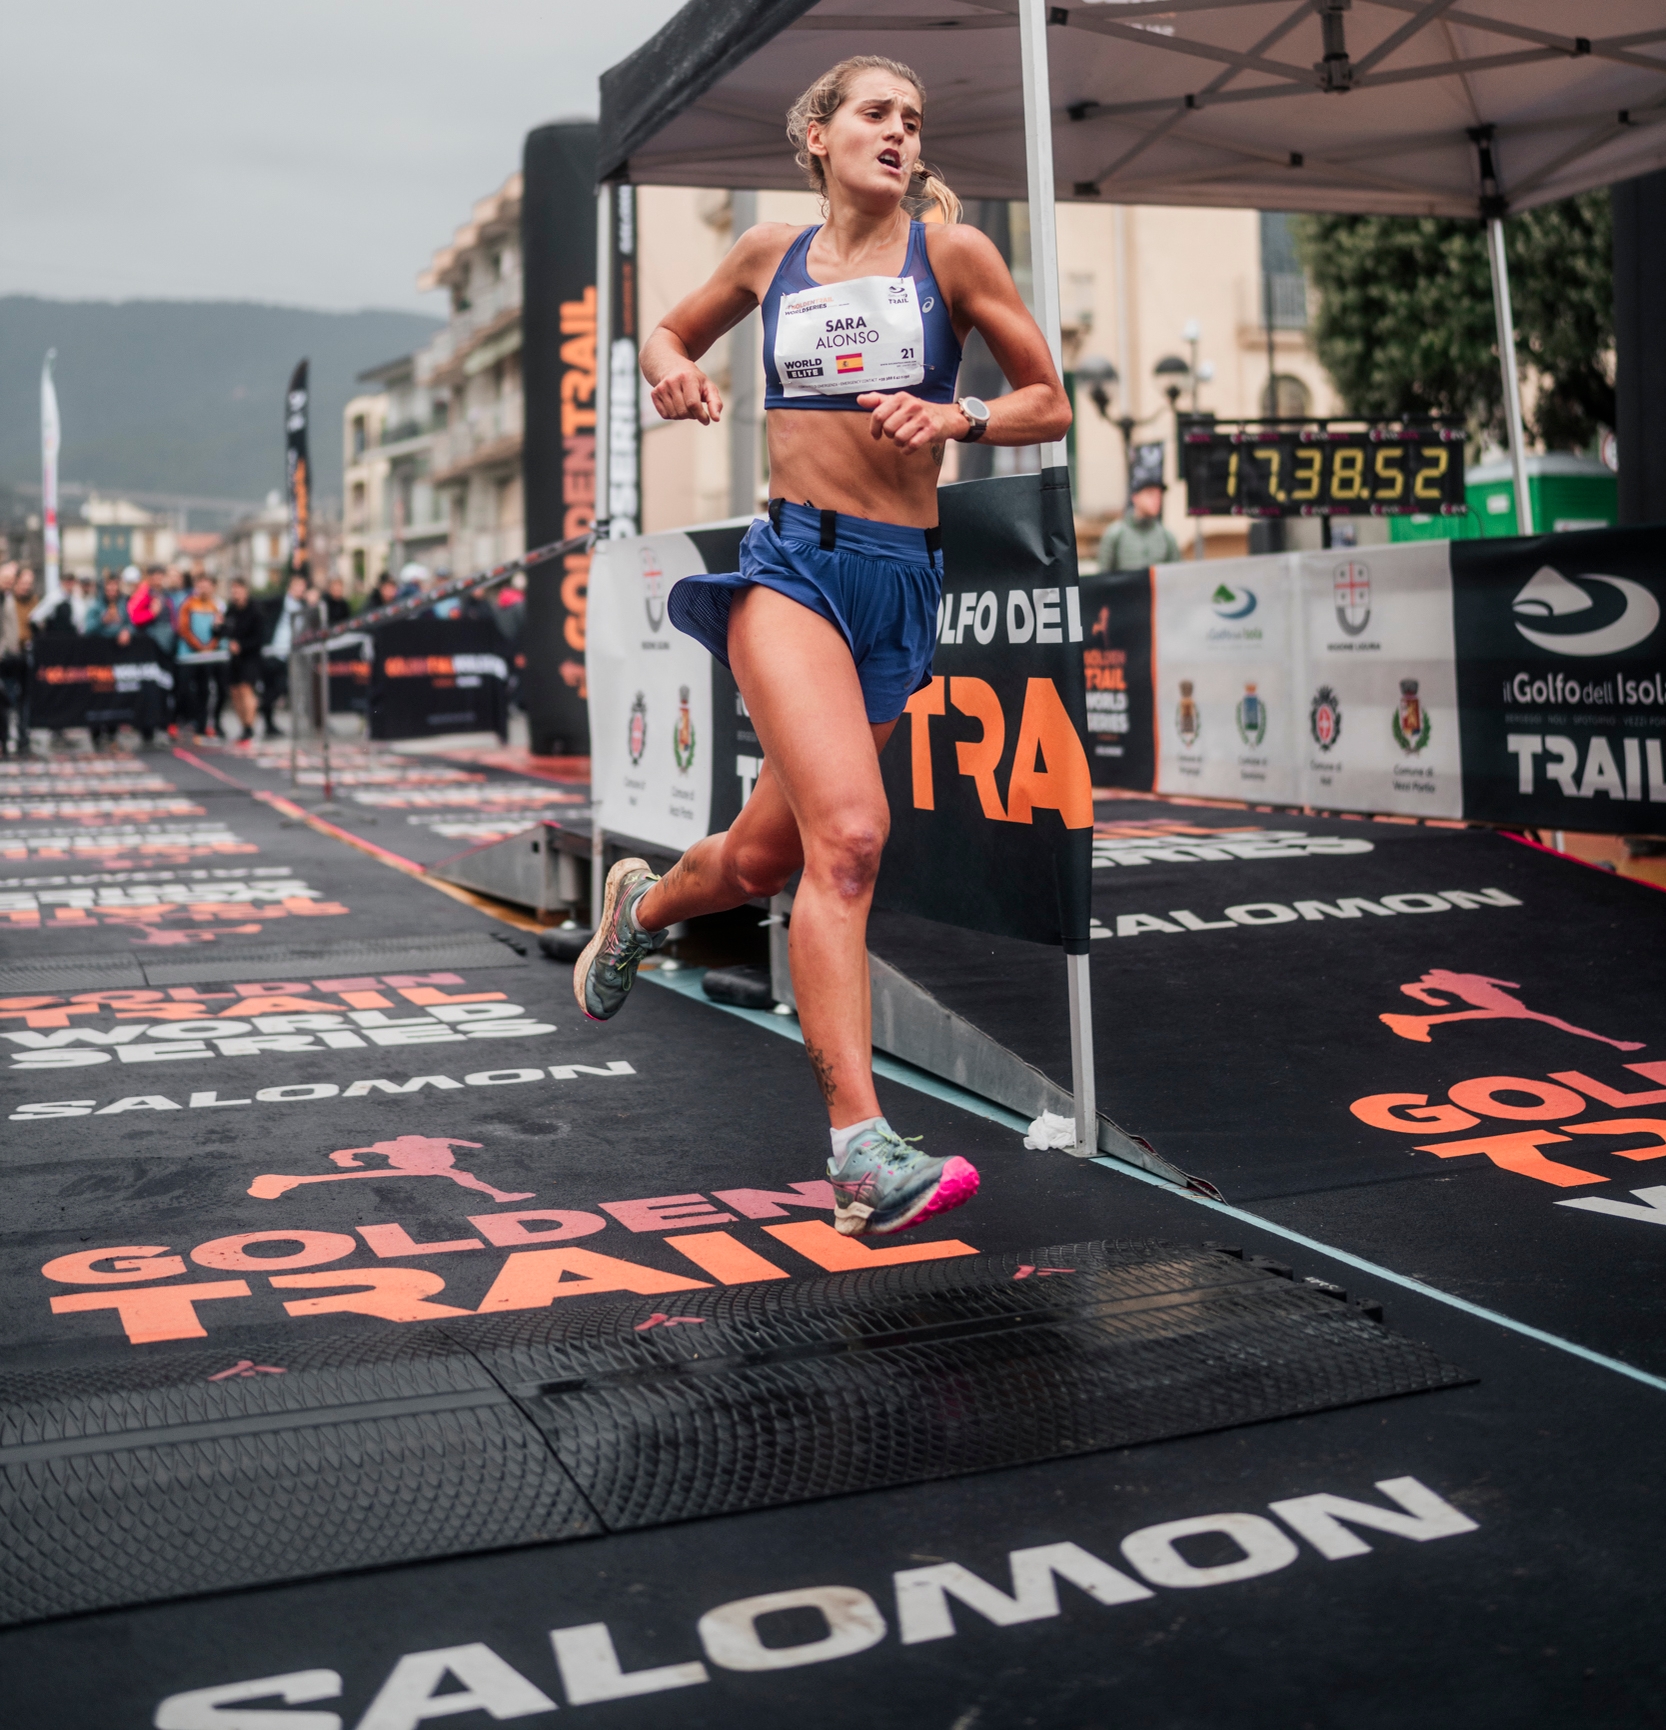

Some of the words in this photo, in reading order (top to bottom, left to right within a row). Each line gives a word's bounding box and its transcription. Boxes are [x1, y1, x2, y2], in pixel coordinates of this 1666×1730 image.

[815, 330, 880, 350] ALONSO
[825, 316, 867, 332] SARA
[784, 358, 823, 370] WORLD
[791, 369, 819, 378] ELITE
[901, 348, 915, 359] 21
[1513, 672, 1581, 704] Golfo
[1617, 672, 1666, 705] Isol
[1507, 734, 1666, 803] TRAIL
[0, 1003, 525, 1049] WORLD
[8, 1018, 557, 1069] SERIES
[8, 1061, 637, 1121] SALOMON
[41, 1180, 836, 1285] GOLDEN
[50, 1219, 981, 1345] TRAIL
[154, 1475, 1481, 1730] SALOMON
